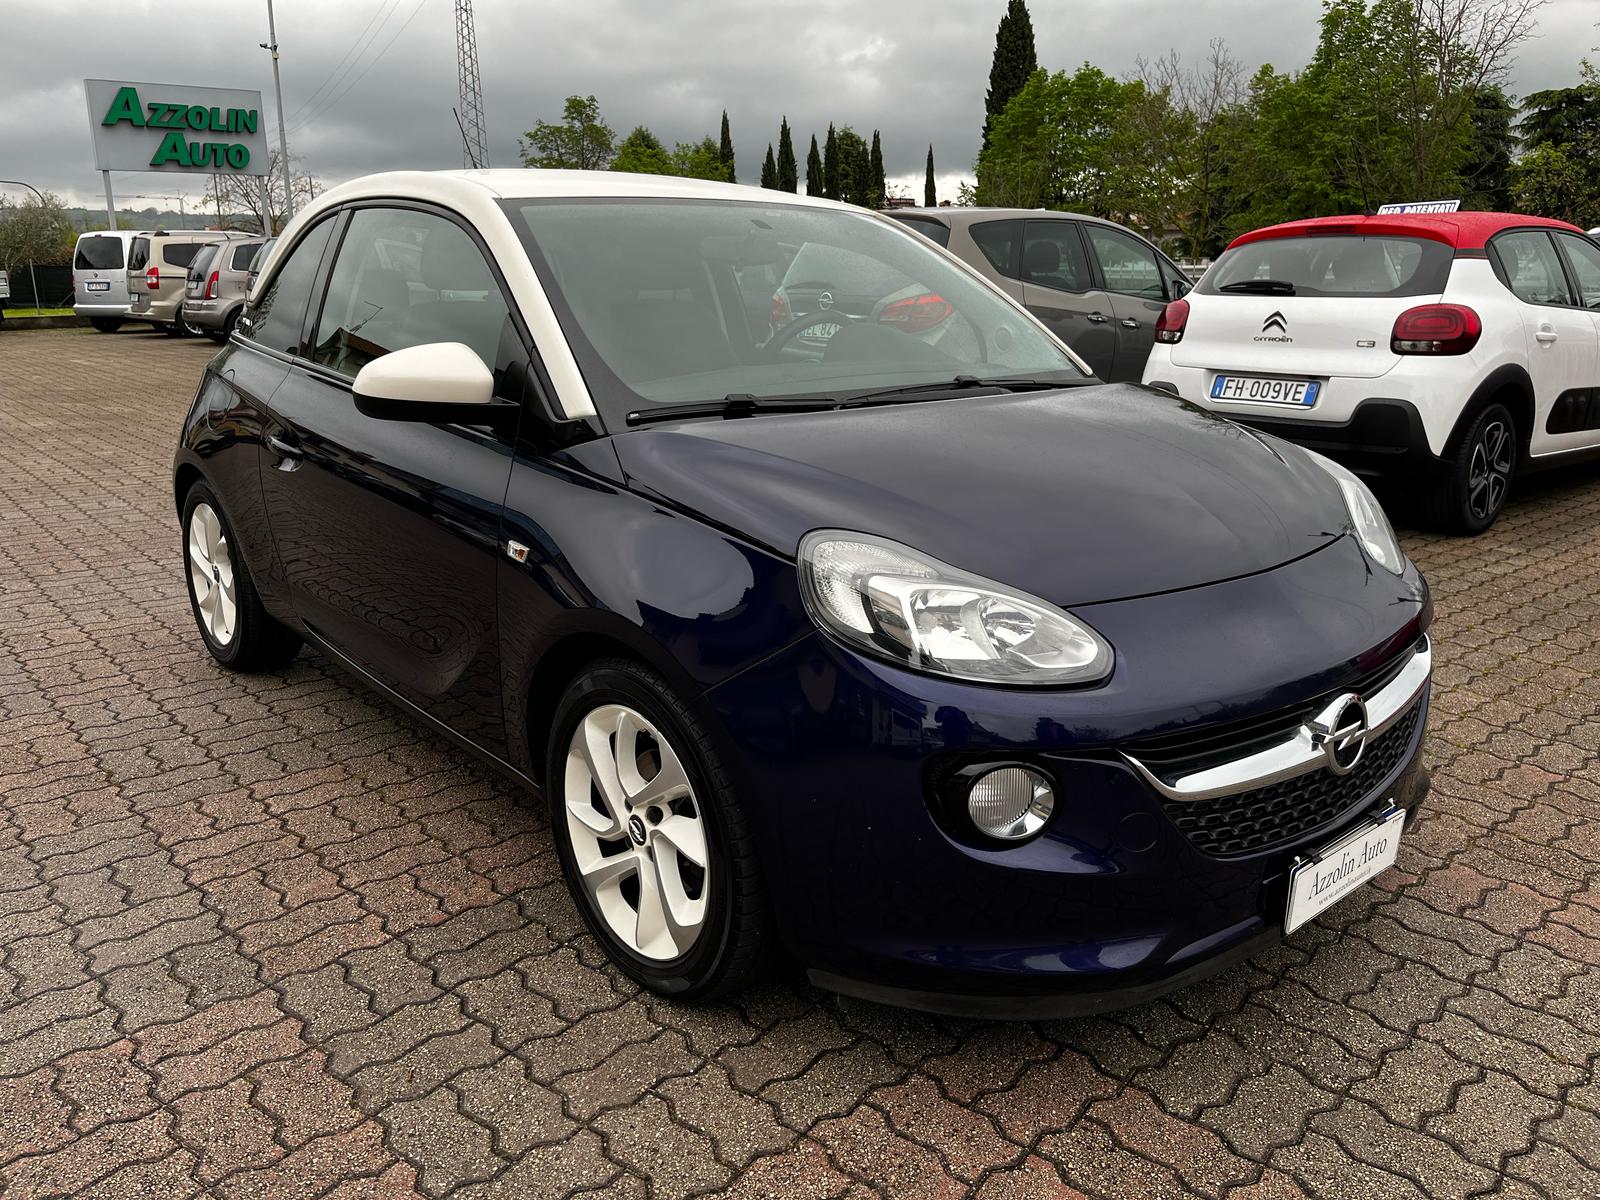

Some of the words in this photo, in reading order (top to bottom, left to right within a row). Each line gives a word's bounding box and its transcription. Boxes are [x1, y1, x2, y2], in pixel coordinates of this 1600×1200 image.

[101, 87, 257, 133] AZZOLIN
[150, 132, 250, 169] AUTO
[1222, 379, 1246, 397] FH
[1249, 380, 1306, 402] 009VE
[1307, 851, 1355, 900] Azzolin
[1358, 839, 1387, 868] Auto
